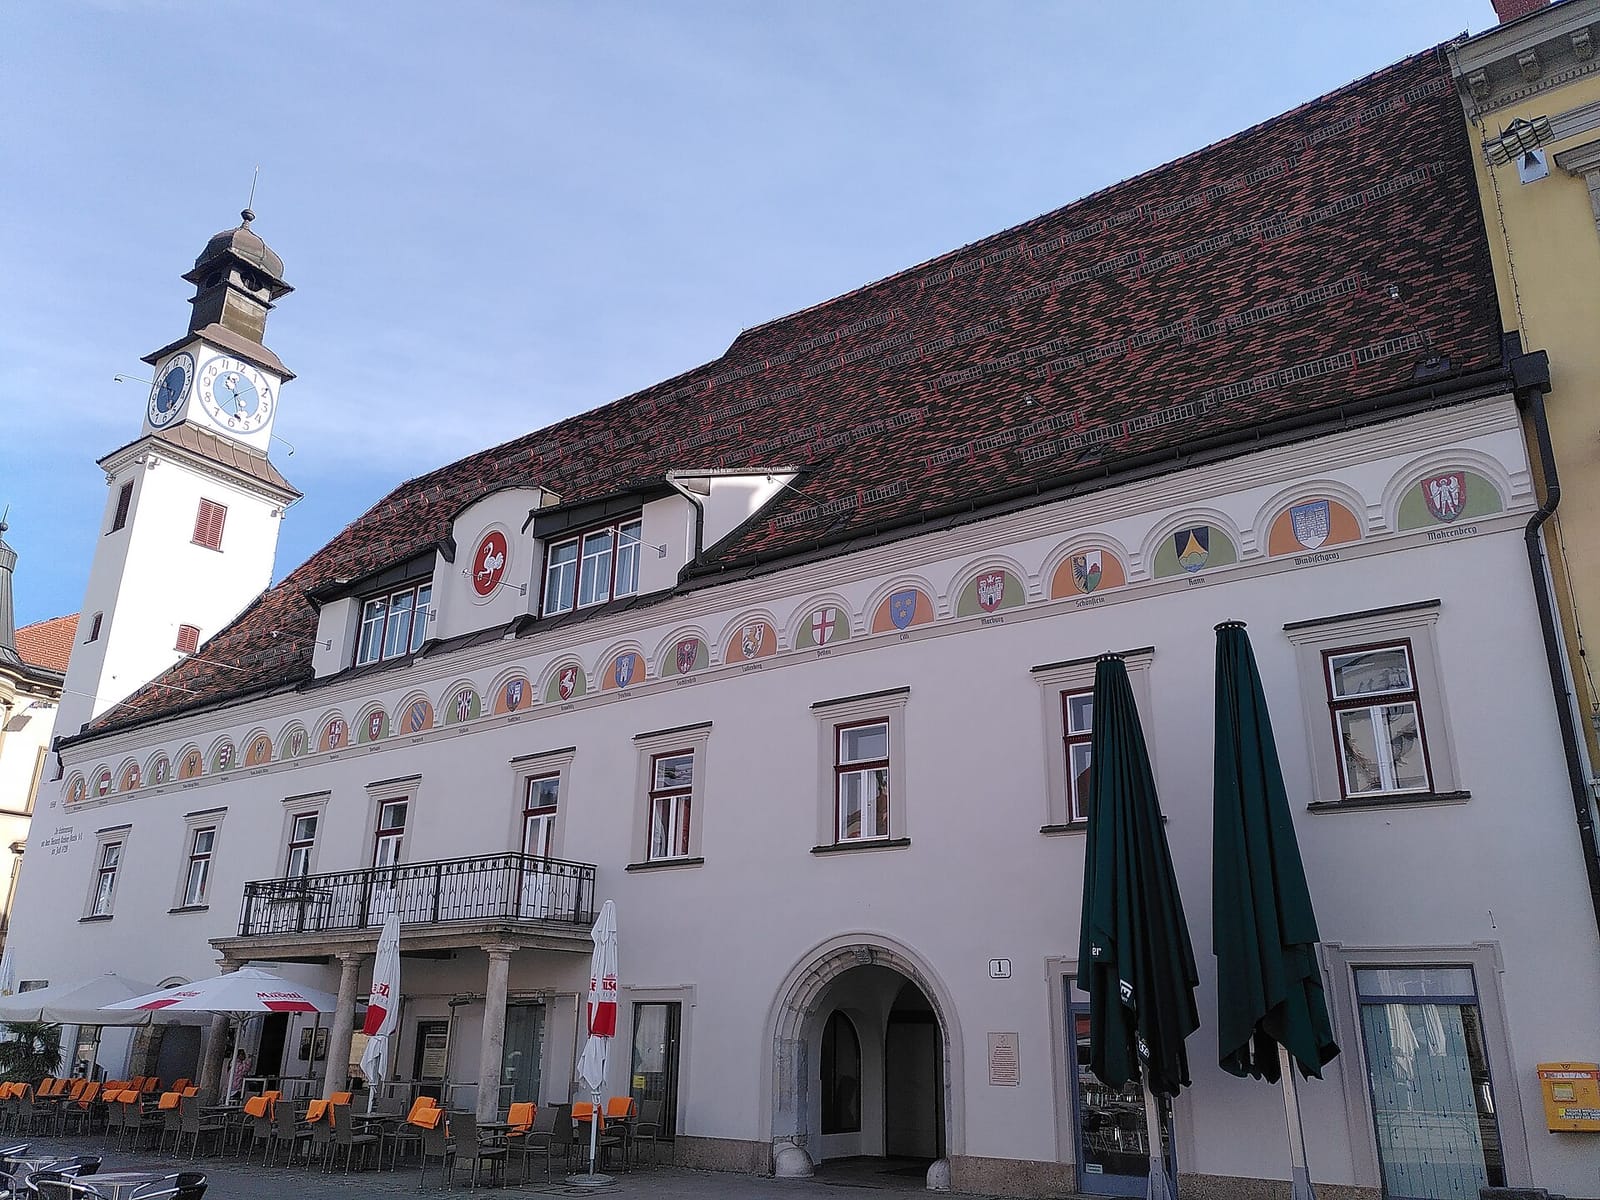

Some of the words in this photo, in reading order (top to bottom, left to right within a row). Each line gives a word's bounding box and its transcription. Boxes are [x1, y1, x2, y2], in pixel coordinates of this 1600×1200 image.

[221, 359, 229, 370] 11
[236, 361, 246, 373] 12
[208, 365, 218, 377] 10
[203, 377, 211, 387] 9
[252, 373, 258, 383] 1
[204, 392, 212, 402] 8
[213, 407, 220, 417] 7
[260, 402, 269, 413] 3
[227, 417, 235, 428] 6
[254, 413, 262, 424] 4
[243, 420, 250, 431] 5
[1427, 526, 1478, 540] Mahrenberg
